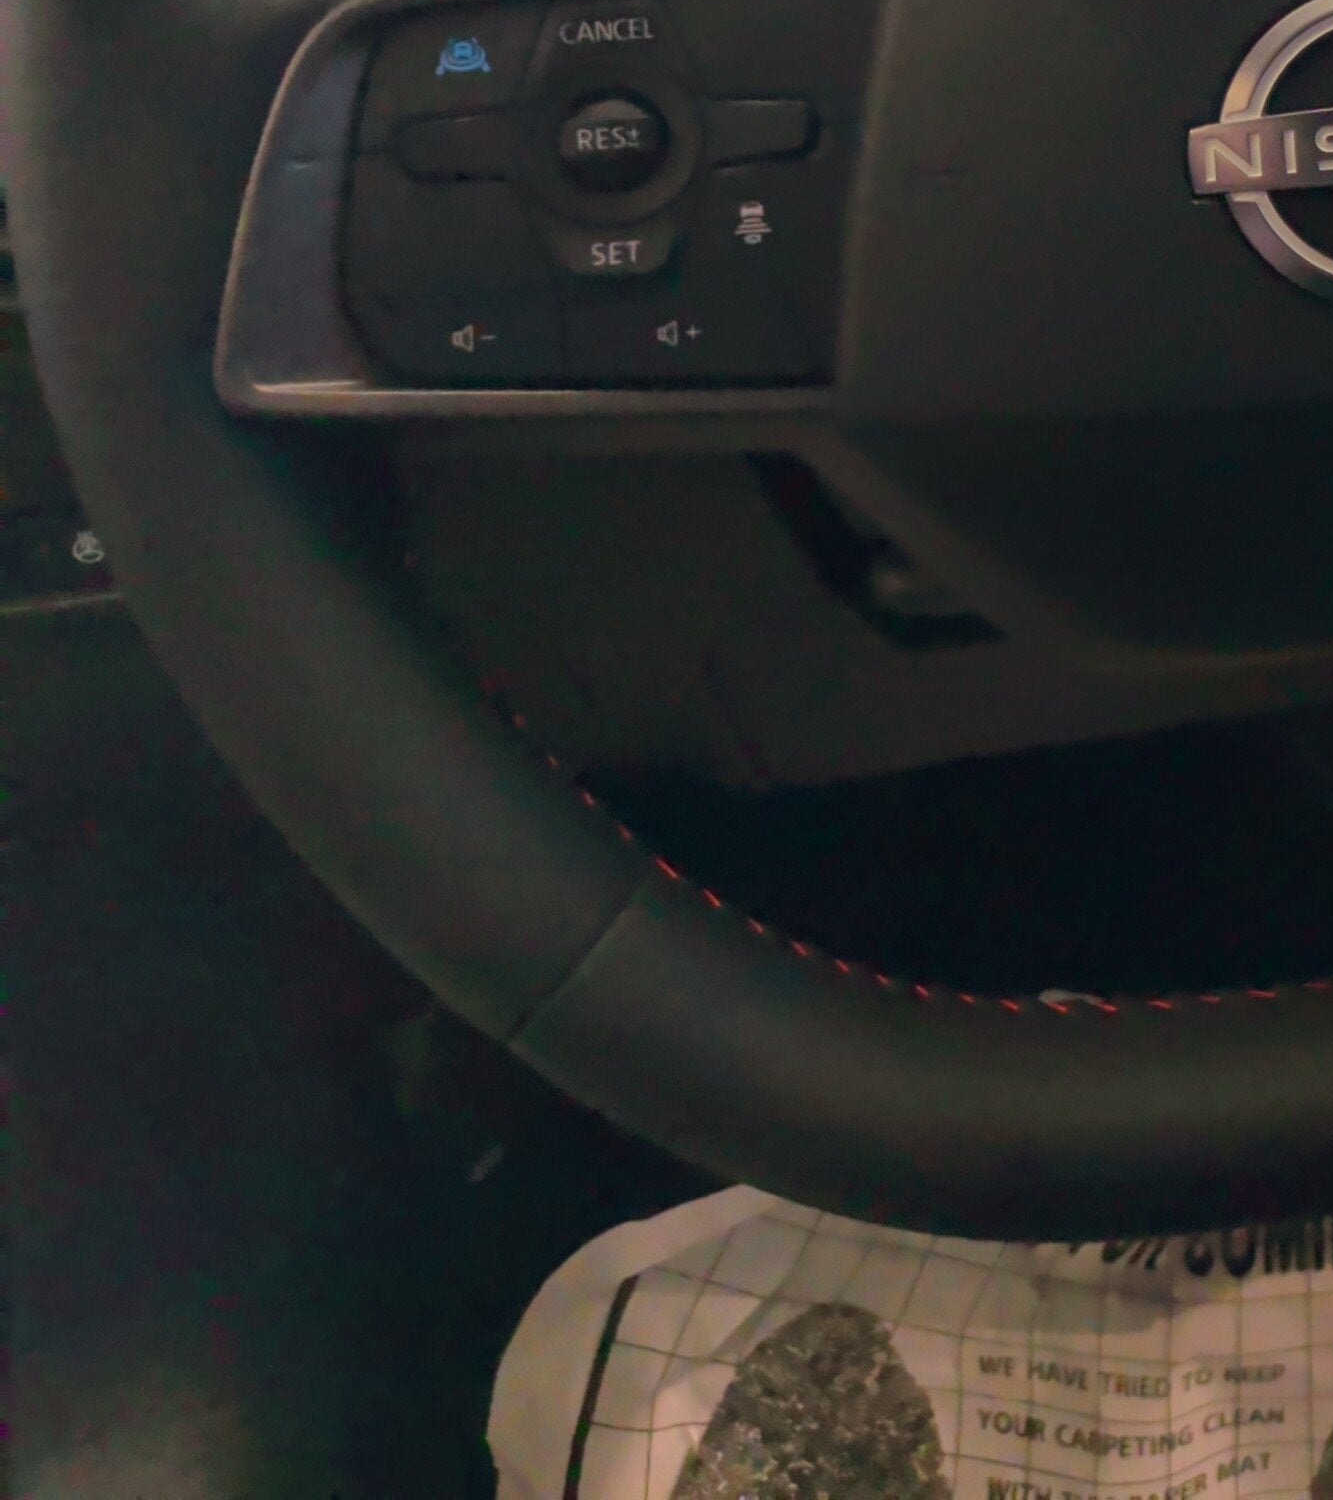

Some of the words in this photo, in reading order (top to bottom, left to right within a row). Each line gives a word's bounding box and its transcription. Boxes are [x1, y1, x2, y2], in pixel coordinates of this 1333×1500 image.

[559, 16, 655, 45] CANCEL
[590, 240, 642, 268] SET
[977, 1354, 1015, 1378] WE
[1027, 1360, 1089, 1391] HAVE
[1098, 1370, 1172, 1399] TRIED
[1181, 1366, 1213, 1392] TO
[977, 1408, 1047, 1441] YOUR
[1053, 1420, 1194, 1458] CARPETING
[1202, 1406, 1286, 1434] CLEAN
[1216, 1451, 1272, 1483] MAT
